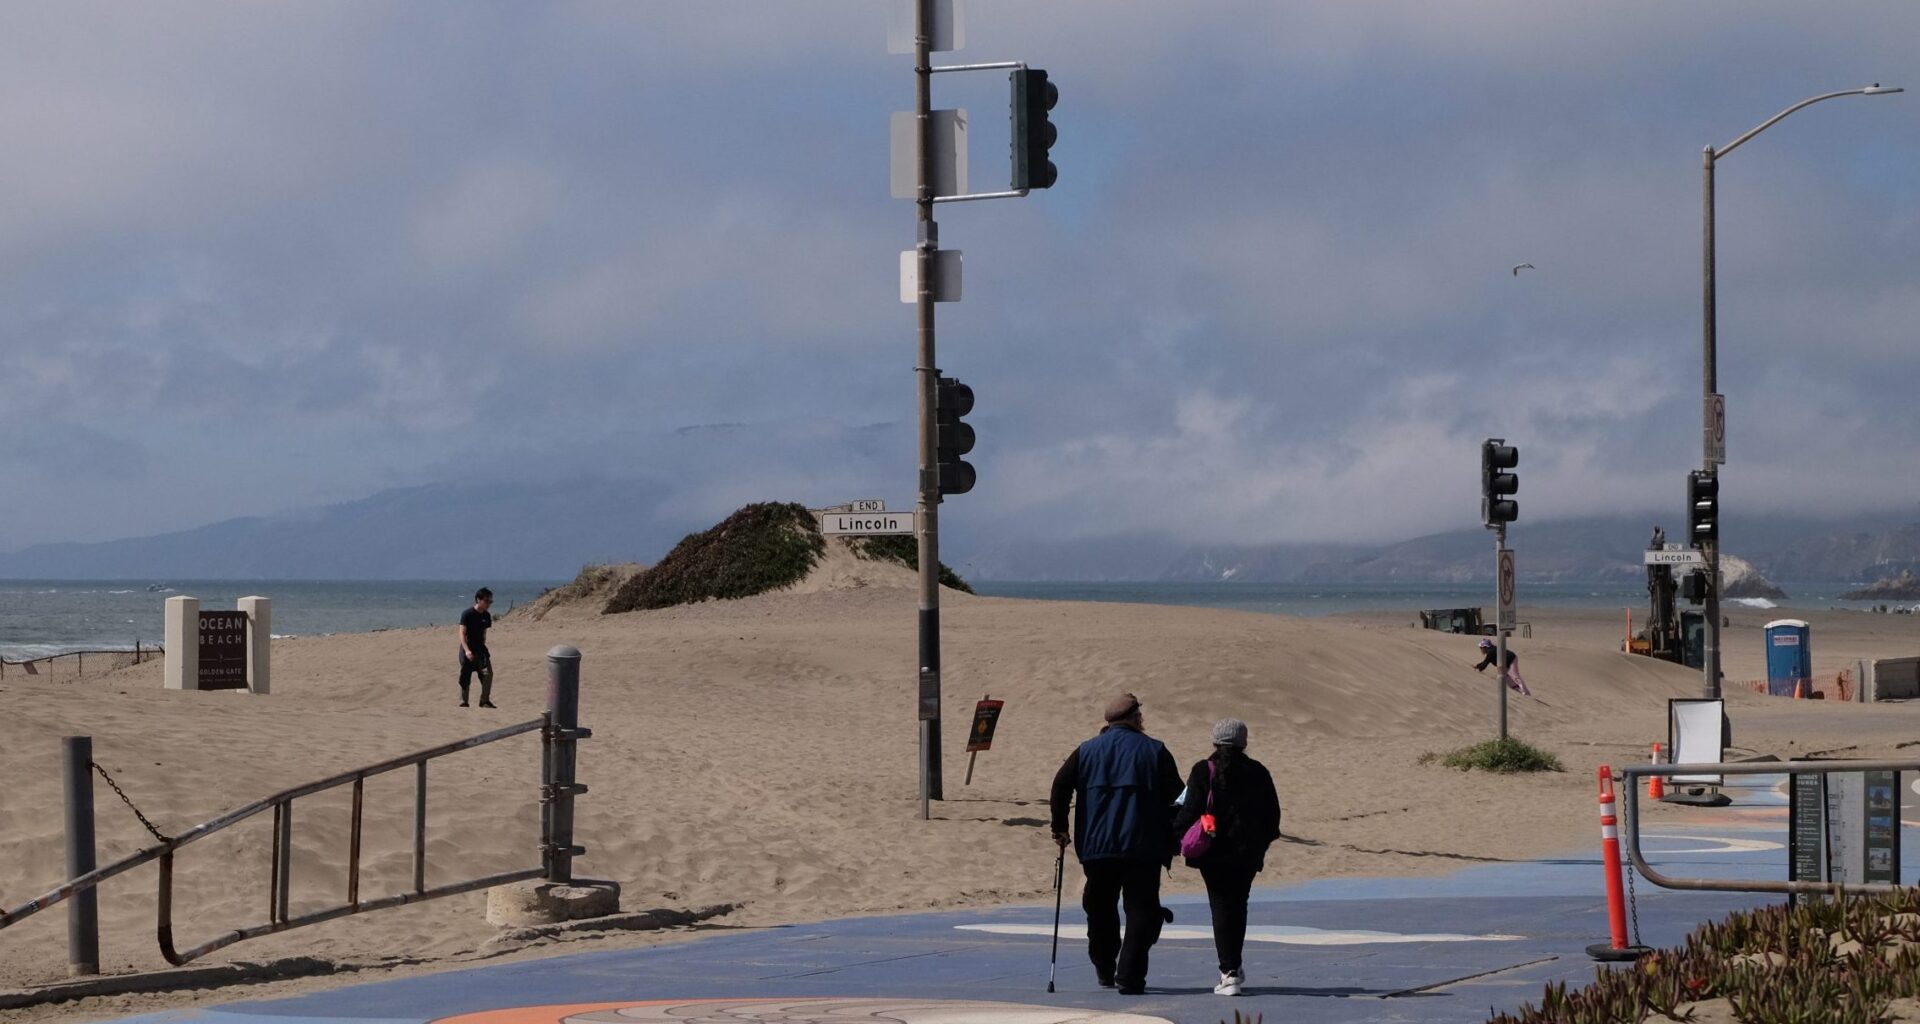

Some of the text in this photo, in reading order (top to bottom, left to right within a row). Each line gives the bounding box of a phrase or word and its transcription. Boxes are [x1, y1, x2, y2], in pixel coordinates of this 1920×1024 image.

[859, 502, 878, 510] END
[839, 517, 898, 530] Lincoln
[1654, 553, 1692, 561] Lincoln
[199, 617, 243, 630] OCEAN
[199, 634, 242, 645] BEACH
